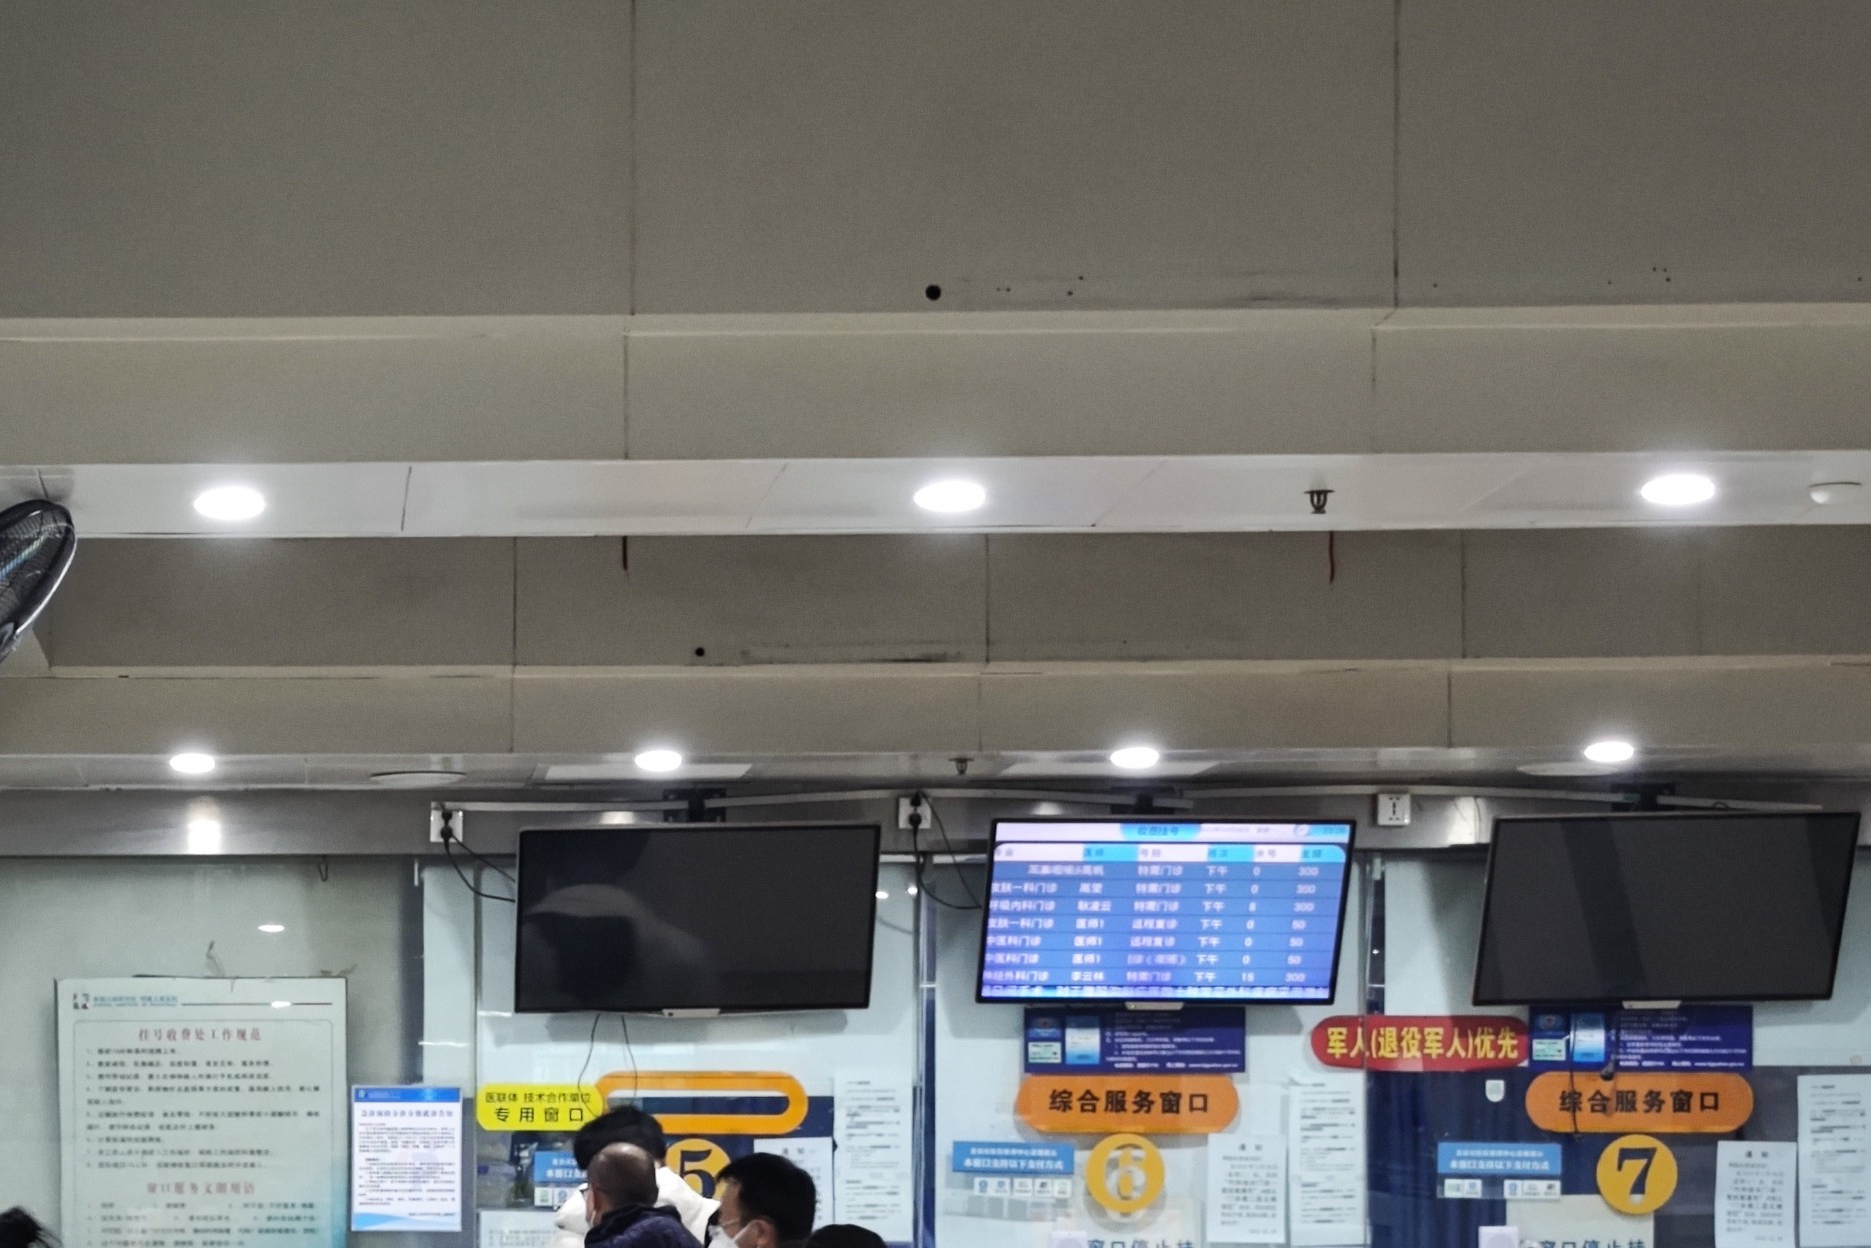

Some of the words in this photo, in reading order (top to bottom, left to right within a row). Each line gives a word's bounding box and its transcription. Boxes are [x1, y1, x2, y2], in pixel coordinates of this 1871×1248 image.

[1206, 866, 1228, 876] 下午
[1298, 867, 1319, 876] 300
[1204, 884, 1226, 894] 下午
[1296, 884, 1316, 894] 300
[1202, 901, 1224, 912] 下午
[1294, 902, 1314, 912] 300
[1201, 919, 1222, 930] 下午
[1198, 937, 1220, 947] 下午
[1196, 954, 1218, 965] 下午
[1194, 972, 1216, 982] 下午
[485, 1092, 518, 1103] 医联体
[1049, 1089, 1209, 1115] 综合服务窗口
[1559, 1090, 1720, 1114] 综合服务窗口
[495, 1107, 583, 1122] 专用窗口
[680, 1149, 716, 1199] 5
[1105, 1145, 1147, 1200] 6
[1617, 1147, 1657, 1204] 7
